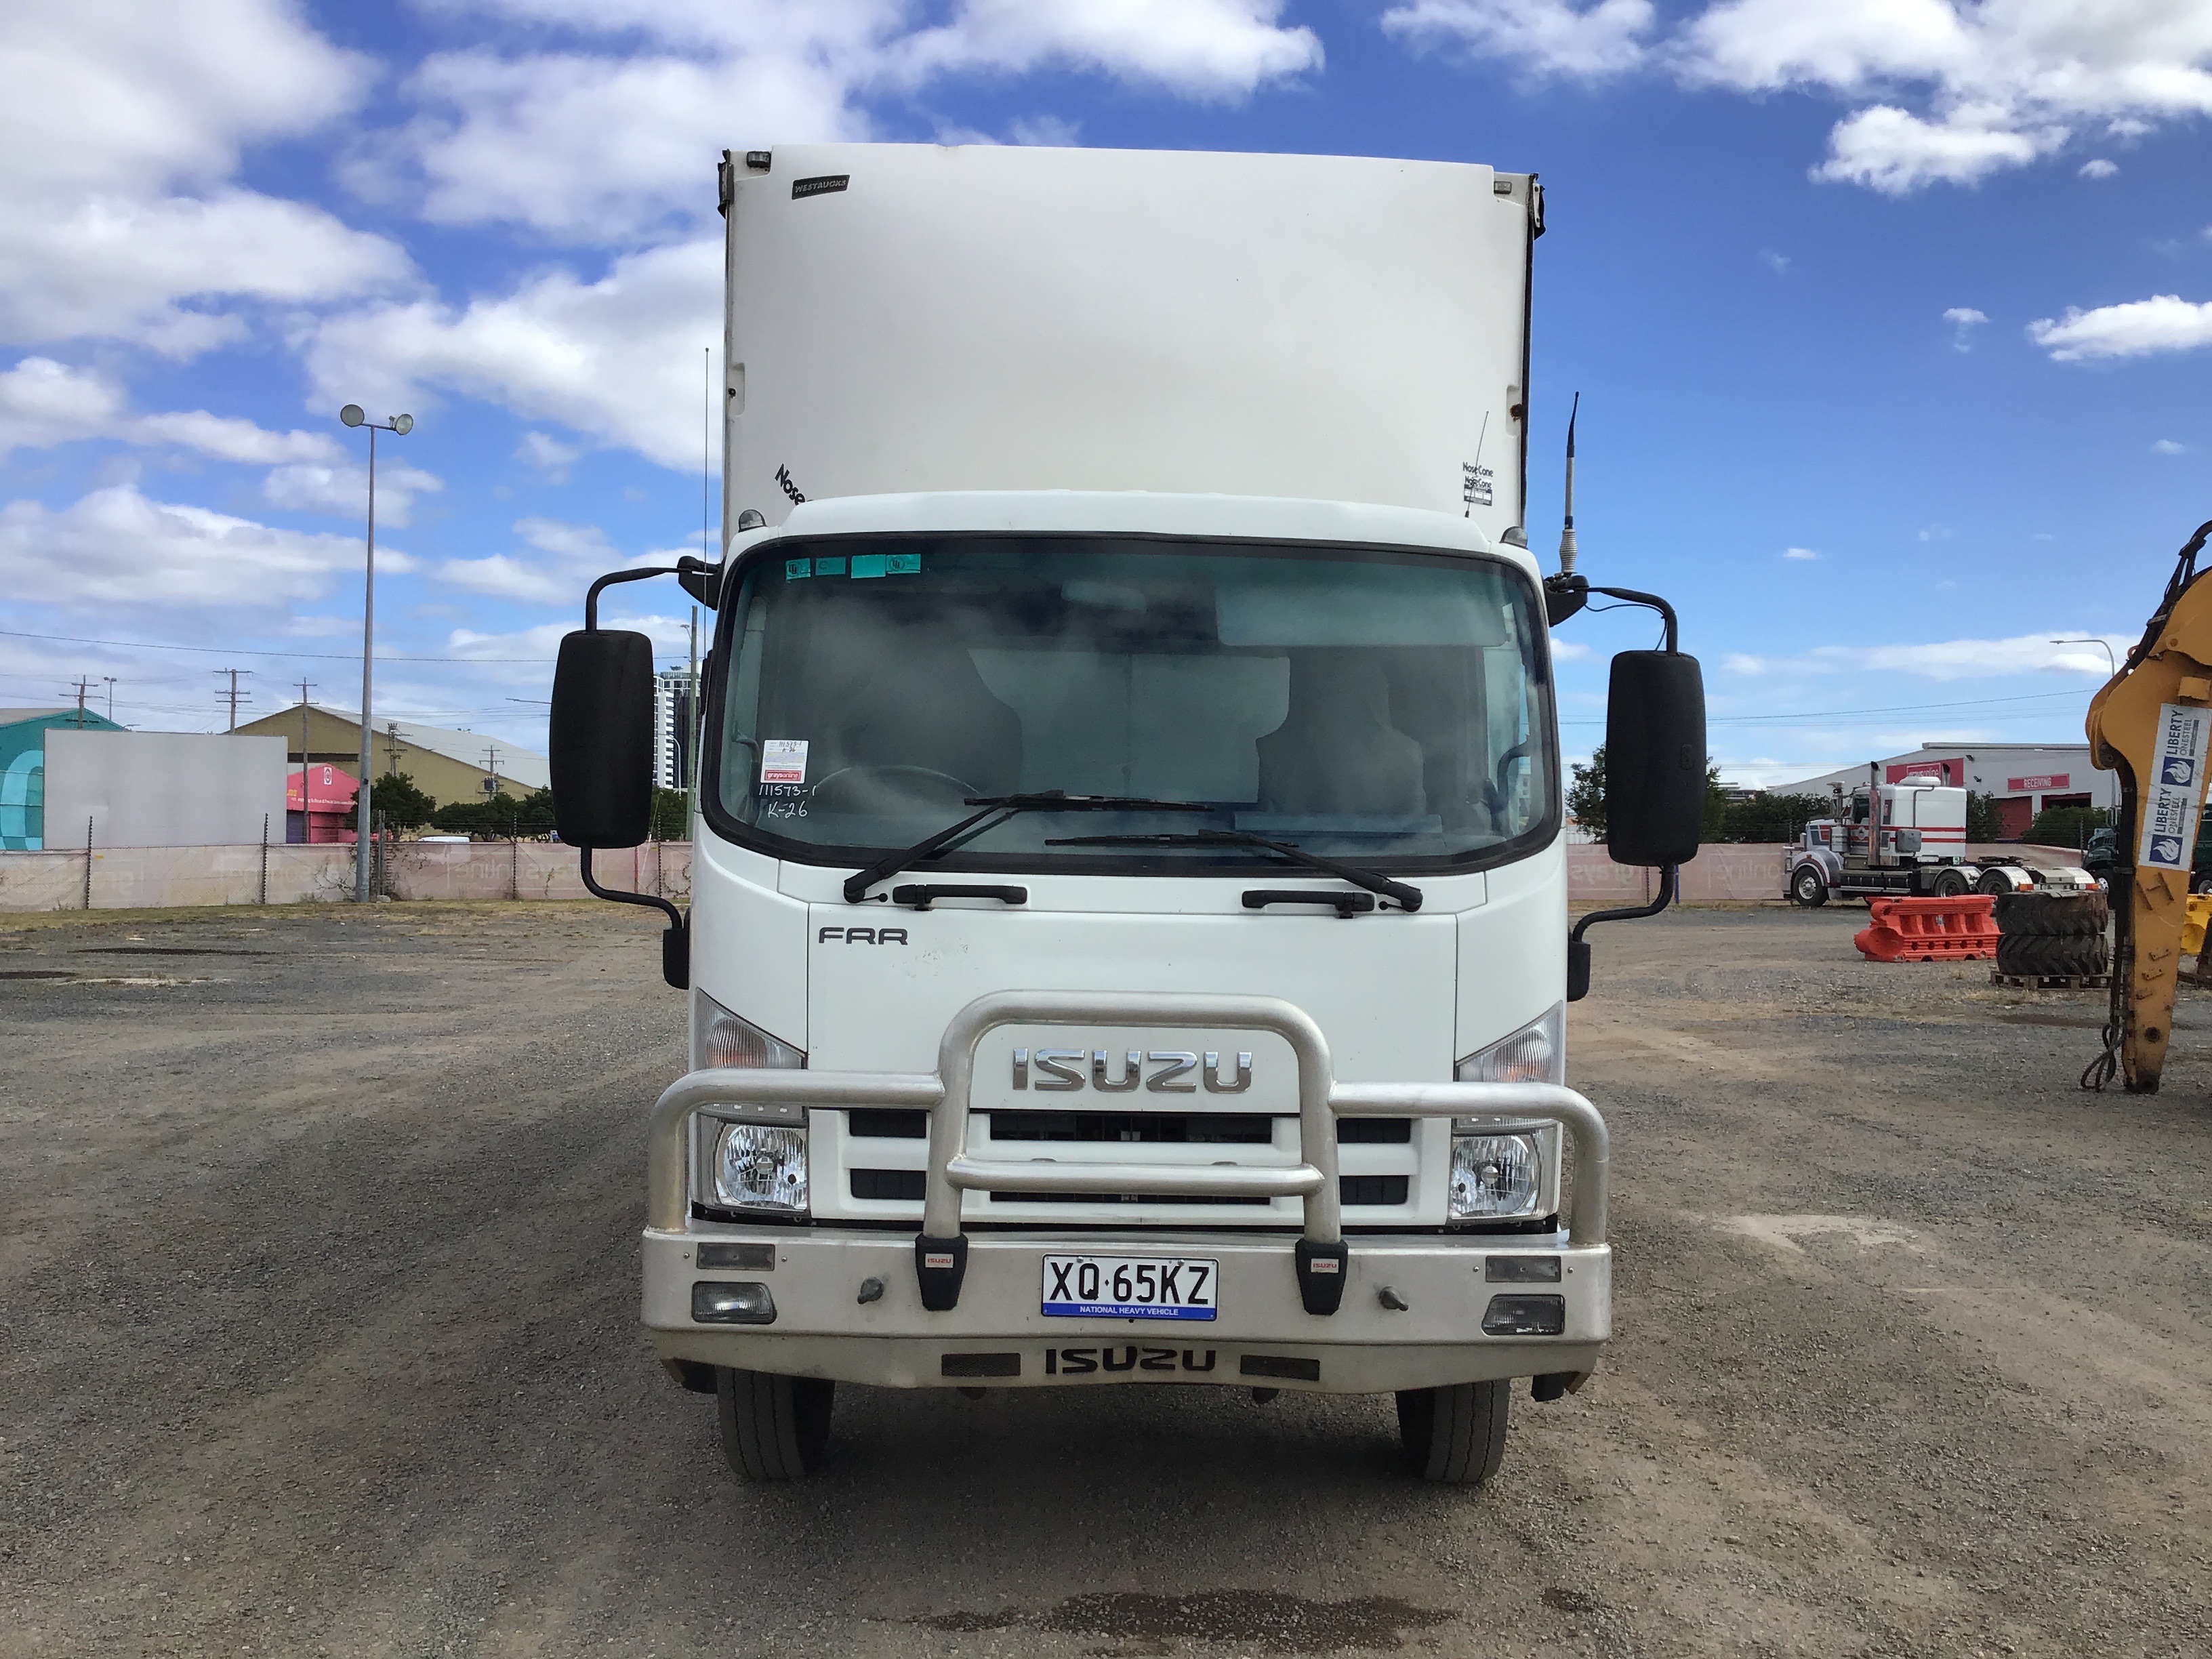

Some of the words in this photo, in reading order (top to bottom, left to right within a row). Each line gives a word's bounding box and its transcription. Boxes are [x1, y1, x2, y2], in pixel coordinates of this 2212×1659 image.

[775, 463, 805, 506] Nose
[1478, 465, 1494, 477] Cone
[2166, 710, 2183, 755] LIBERTY
[2179, 718, 2192, 756] ONESTEEL
[2024, 777, 2051, 788] RECEIVING
[2154, 787, 2172, 833] LIBERTY
[2168, 796, 2180, 834] ONESTEEL
[819, 927, 908, 945] FRR
[1012, 1047, 1252, 1094] ISUZU
[1080, 1305, 1118, 1314] NATIONAL
[1046, 1346, 1216, 1374] ISUZU
